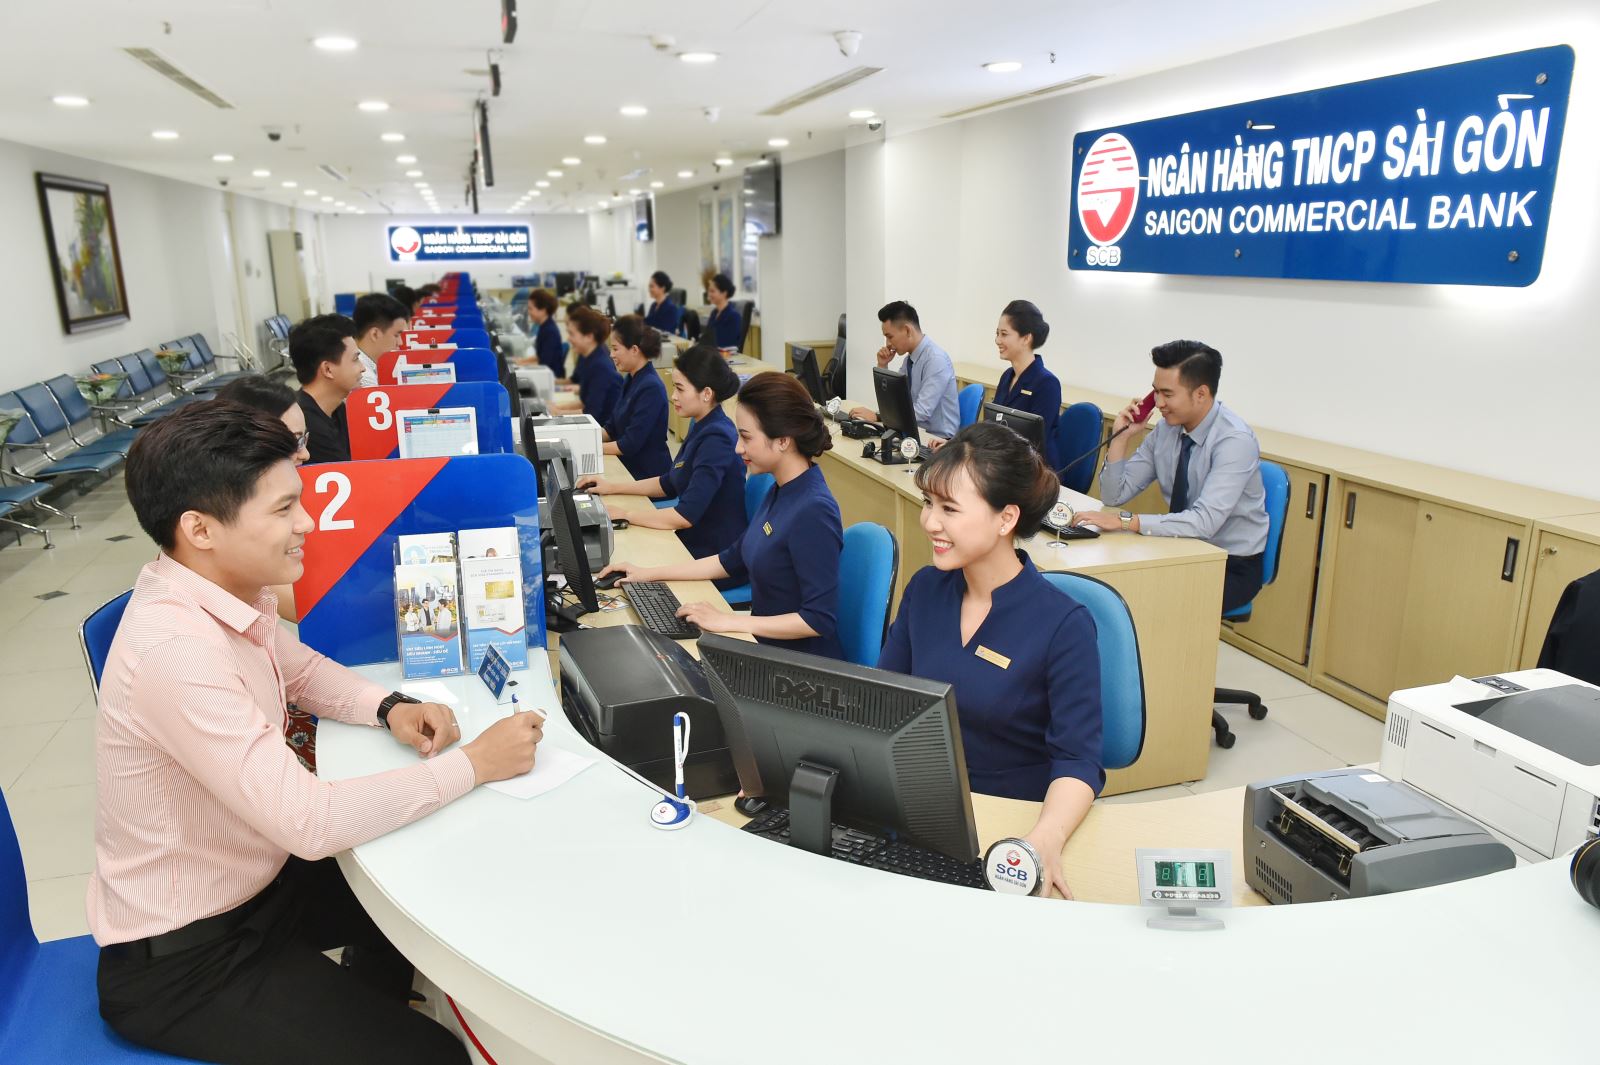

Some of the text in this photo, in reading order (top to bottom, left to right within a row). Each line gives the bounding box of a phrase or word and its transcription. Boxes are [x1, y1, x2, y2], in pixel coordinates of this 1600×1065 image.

[1147, 96, 1550, 197] NGÂN HÀNG TMCP SÀI GÒN
[1144, 190, 1538, 236] SAIGON COMMERCIAL BANK
[1086, 246, 1121, 266] SCB
[366, 391, 393, 431] 3
[314, 471, 355, 531] 2
[774, 675, 847, 713] DELL
[996, 863, 1028, 881] SCB
